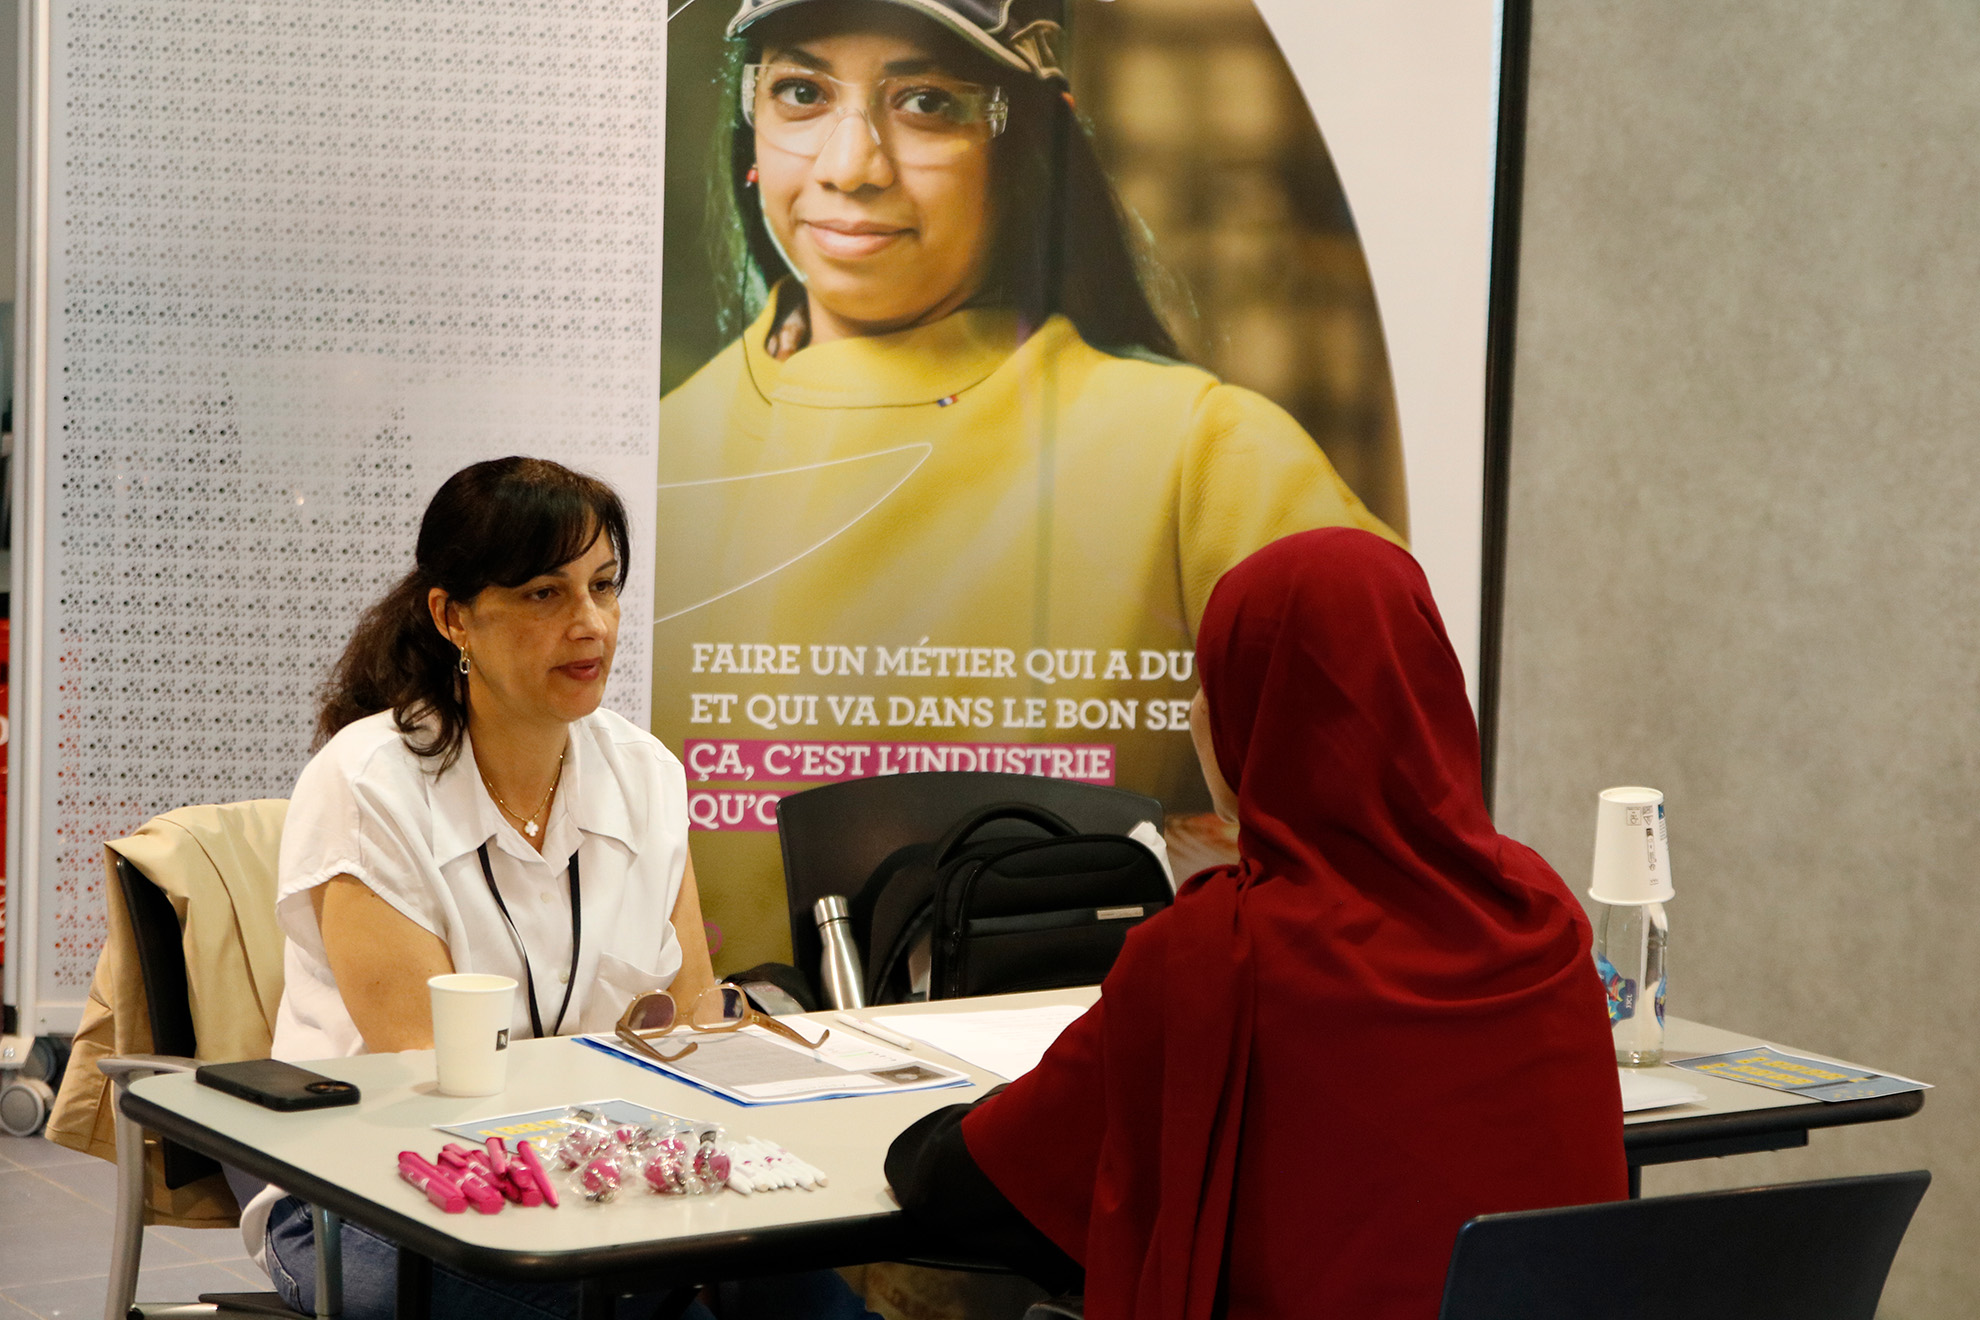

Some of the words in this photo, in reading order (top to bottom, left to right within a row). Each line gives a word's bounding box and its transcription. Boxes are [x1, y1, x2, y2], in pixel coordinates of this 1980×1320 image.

[692, 644, 800, 674] FAIRE
[810, 647, 867, 675] UN
[876, 636, 1016, 677] MÉTIER
[1026, 649, 1095, 683] QUI
[1104, 651, 1132, 680] A
[1140, 650, 1195, 681] DU
[691, 694, 738, 723] ET
[746, 695, 818, 729] QUI
[827, 696, 880, 726] VA
[888, 697, 993, 727] DANS
[1003, 699, 1046, 728] LE
[1055, 699, 1138, 729] BON
[1147, 701, 1190, 730] SE
[690, 744, 754, 781] ÇA,
[764, 745, 870, 775] C’EST
[878, 746, 1111, 779] L’INDUSTRIE
